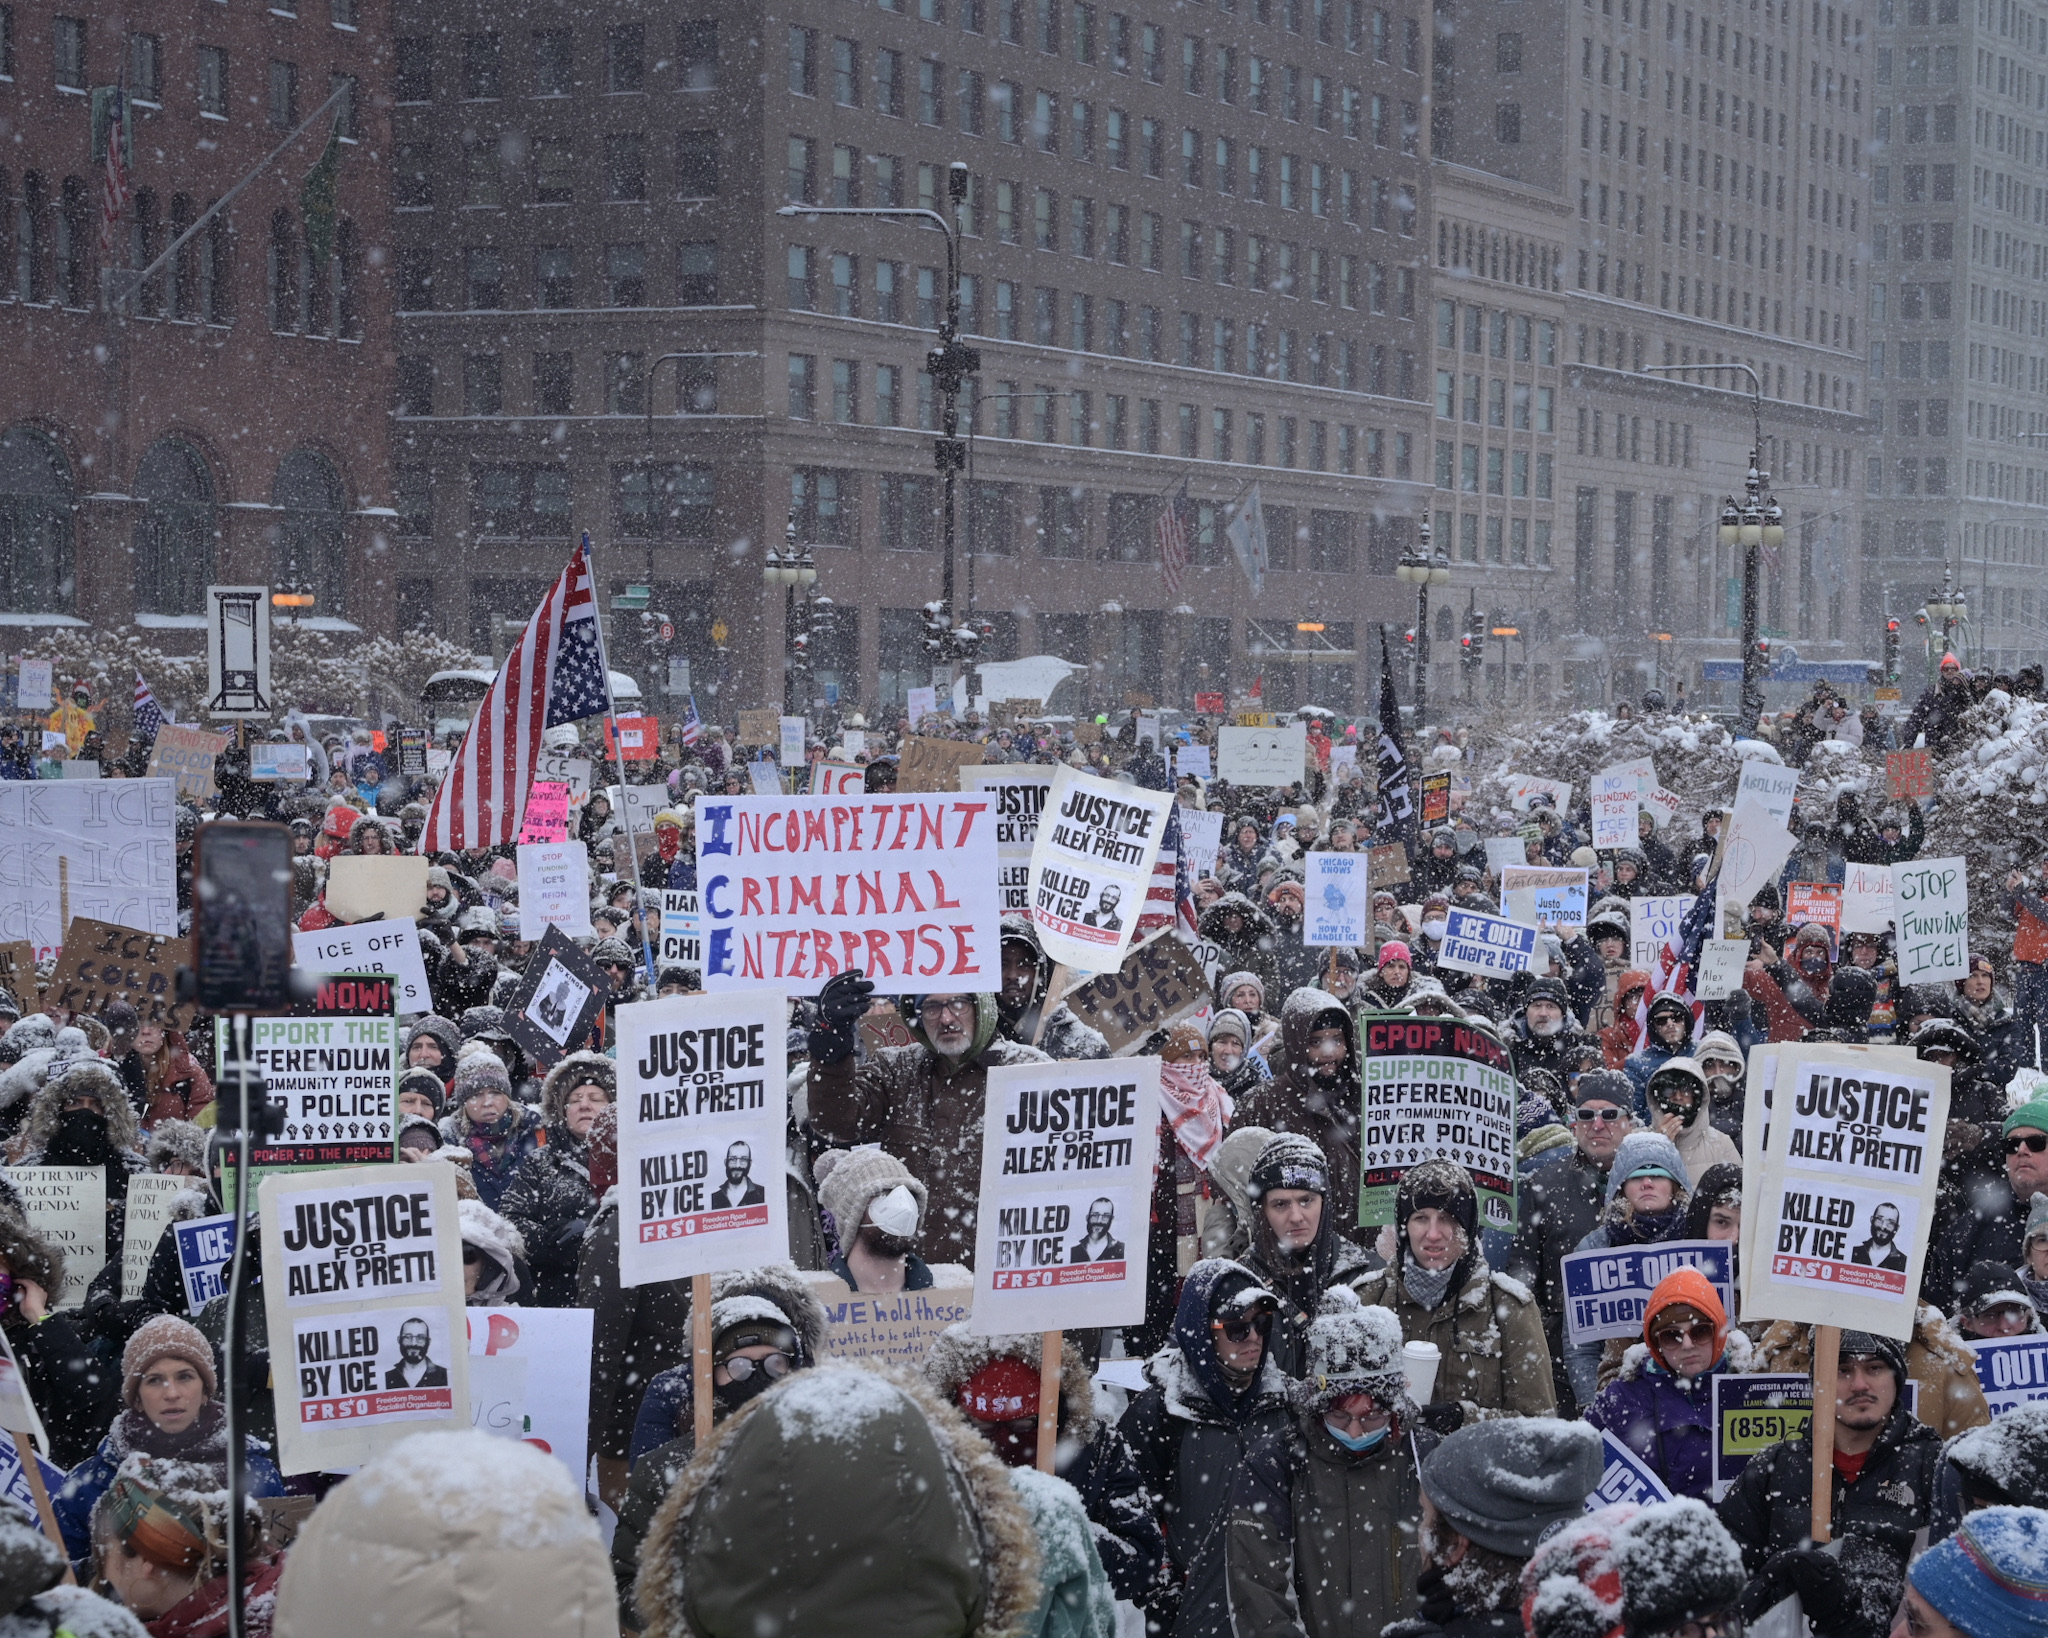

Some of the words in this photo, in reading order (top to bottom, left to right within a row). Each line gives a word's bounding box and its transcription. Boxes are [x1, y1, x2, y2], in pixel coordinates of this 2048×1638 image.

[663, 626, 671, 637] B
[162, 729, 197, 747] STAND
[198, 734, 228, 752] FOR
[160, 747, 212, 769] GOOD
[1887, 752, 1931, 775] FUCK
[1604, 777, 1621, 792] NO
[1742, 774, 1793, 795] ABOLISH
[1892, 775, 1929, 797] ICE
[83, 782, 170, 828] ICE
[1593, 791, 1637, 806] FUNDING
[1604, 804, 1625, 815] FOR
[1061, 791, 1154, 839] JUSTICE
[1596, 817, 1634, 832] ICE!
[701, 802, 988, 857] INCOMPETENT
[1086, 825, 1119, 840] FOR
[1599, 830, 1626, 845] DHS!
[1051, 825, 1092, 853] ALEX
[1092, 837, 1145, 866] PRETTI
[83, 840, 170, 888] ICE
[537, 864, 568, 872] FUNDING
[542, 853, 563, 861] STOP
[1319, 858, 1354, 867] CHICAGO
[542, 876, 566, 884] ICE'S
[1321, 866, 1351, 875] KNOWS
[1506, 874, 1527, 890] For
[1549, 872, 1585, 887] People
[705, 869, 961, 919] CRIMINAL
[1040, 867, 1090, 899] KILLED
[1901, 869, 1957, 901] STOP
[542, 891, 567, 899] REIGN
[1037, 888, 1056, 910] BY
[1056, 898, 1082, 921] ICE
[1538, 898, 1561, 909] Justo
[540, 914, 571, 923] TERROR
[1551, 911, 1581, 921] TODOS
[1792, 914, 1835, 923] IMMIGRANTS
[1808, 907, 1835, 915] DEFEND
[1312, 933, 1343, 941] HANDLE
[1345, 933, 1358, 941] ICE
[1318, 925, 1339, 934] HOW
[1340, 926, 1351, 934] TO
[1460, 917, 1485, 939] ICE
[1488, 923, 1523, 949] OUT!
[94, 930, 168, 963] ICE
[317, 941, 353, 959] ICE
[368, 934, 404, 951] OFF
[707, 924, 981, 979] ENTERPRISE
[1709, 942, 1735, 952] Justice
[1908, 937, 1962, 975] ICE!
[77, 961, 168, 994] COLD
[555, 963, 564, 973] NO
[565, 973, 584, 991] KINGS
[1075, 943, 1170, 1016] FUCK
[1702, 970, 1724, 982] Alex
[317, 982, 390, 1010] NOW!
[1704, 985, 1725, 997] Pretti
[344, 1022, 389, 1044] THE
[639, 1024, 764, 1079] JUSTICE
[1370, 1025, 1441, 1050] CPOP
[1454, 1028, 1510, 1068] NOW!
[344, 1076, 391, 1089] POWER
[679, 1071, 724, 1087] FOR
[1368, 1060, 1468, 1081] SUPPORT
[1477, 1067, 1511, 1096] THE
[301, 1094, 390, 1118] POLICE
[639, 1087, 689, 1123] ALEX
[696, 1079, 764, 1115] PRETTI
[1007, 1084, 1136, 1134] JUSTICE
[1368, 1083, 1511, 1119] REFERENDUM
[1796, 1074, 1929, 1133] JUSTICE
[1368, 1109, 1390, 1122] FOR
[1397, 1108, 1470, 1122] COMMUNITY
[1476, 1115, 1511, 1136] POWER
[1836, 1121, 1882, 1138] FOR
[1048, 1131, 1094, 1144] FOR
[1368, 1123, 1425, 1147] OVER
[1437, 1123, 1511, 1158] POLICE
[254, 1149, 294, 1162] POWER
[299, 1148, 314, 1160] TO
[319, 1148, 341, 1160] THE
[345, 1147, 391, 1159] PEOPLE
[1002, 1144, 1057, 1175] ALEX
[1062, 1138, 1132, 1170] PRETTI
[1789, 1128, 1845, 1162] ALEX
[1849, 1136, 1922, 1174] PRETTI
[39, 1171, 98, 1182] TRUMP'S
[640, 1150, 708, 1188] KILLED
[25, 1186, 73, 1196] RACIST
[142, 1179, 178, 1192] TRUMP'S
[1367, 1173, 1384, 1183] ALL
[1475, 1174, 1511, 1192] PEOPLE
[133, 1194, 157, 1205] RACIST
[642, 1188, 667, 1220] BY
[673, 1183, 704, 1215] ICE
[1782, 1192, 1854, 1229] KILLED
[284, 1193, 432, 1252] JUSTICE
[702, 1214, 729, 1224] Freedom
[730, 1212, 747, 1221] Road
[702, 1222, 727, 1231] Socialist
[728, 1217, 766, 1227] Organization
[998, 1205, 1070, 1237] KILLED
[643, 1218, 695, 1242] FRSO
[195, 1226, 232, 1262] ICE
[335, 1242, 386, 1260] FOR
[996, 1240, 1026, 1269] BY
[1031, 1236, 1063, 1266] ICE
[1777, 1225, 1809, 1253] BY
[1812, 1229, 1847, 1260] ICE
[289, 1259, 349, 1296] ALEX
[356, 1250, 435, 1287] PRETTI
[1060, 1269, 1085, 1277] Freedom
[1085, 1271, 1123, 1281] Organization
[1590, 1258, 1635, 1291] ICE
[1840, 1267, 1867, 1278] Freedom
[1868, 1271, 1885, 1281] Road
[1865, 1279, 1903, 1292] Organization
[826, 1302, 867, 1324] WE
[873, 1298, 911, 1321] hold
[915, 1296, 964, 1321] these
[298, 1326, 379, 1363] KILLED
[871, 1328, 884, 1342] to
[300, 1366, 331, 1399] BY
[340, 1361, 378, 1394] ICE
[1749, 1384, 1781, 1392] ¿NECESITA
[305, 1398, 368, 1421] FRSO
[376, 1396, 407, 1404] Freedom
[408, 1394, 426, 1402] Road
[377, 1402, 405, 1411] Socialist
[407, 1400, 450, 1409] Organization
